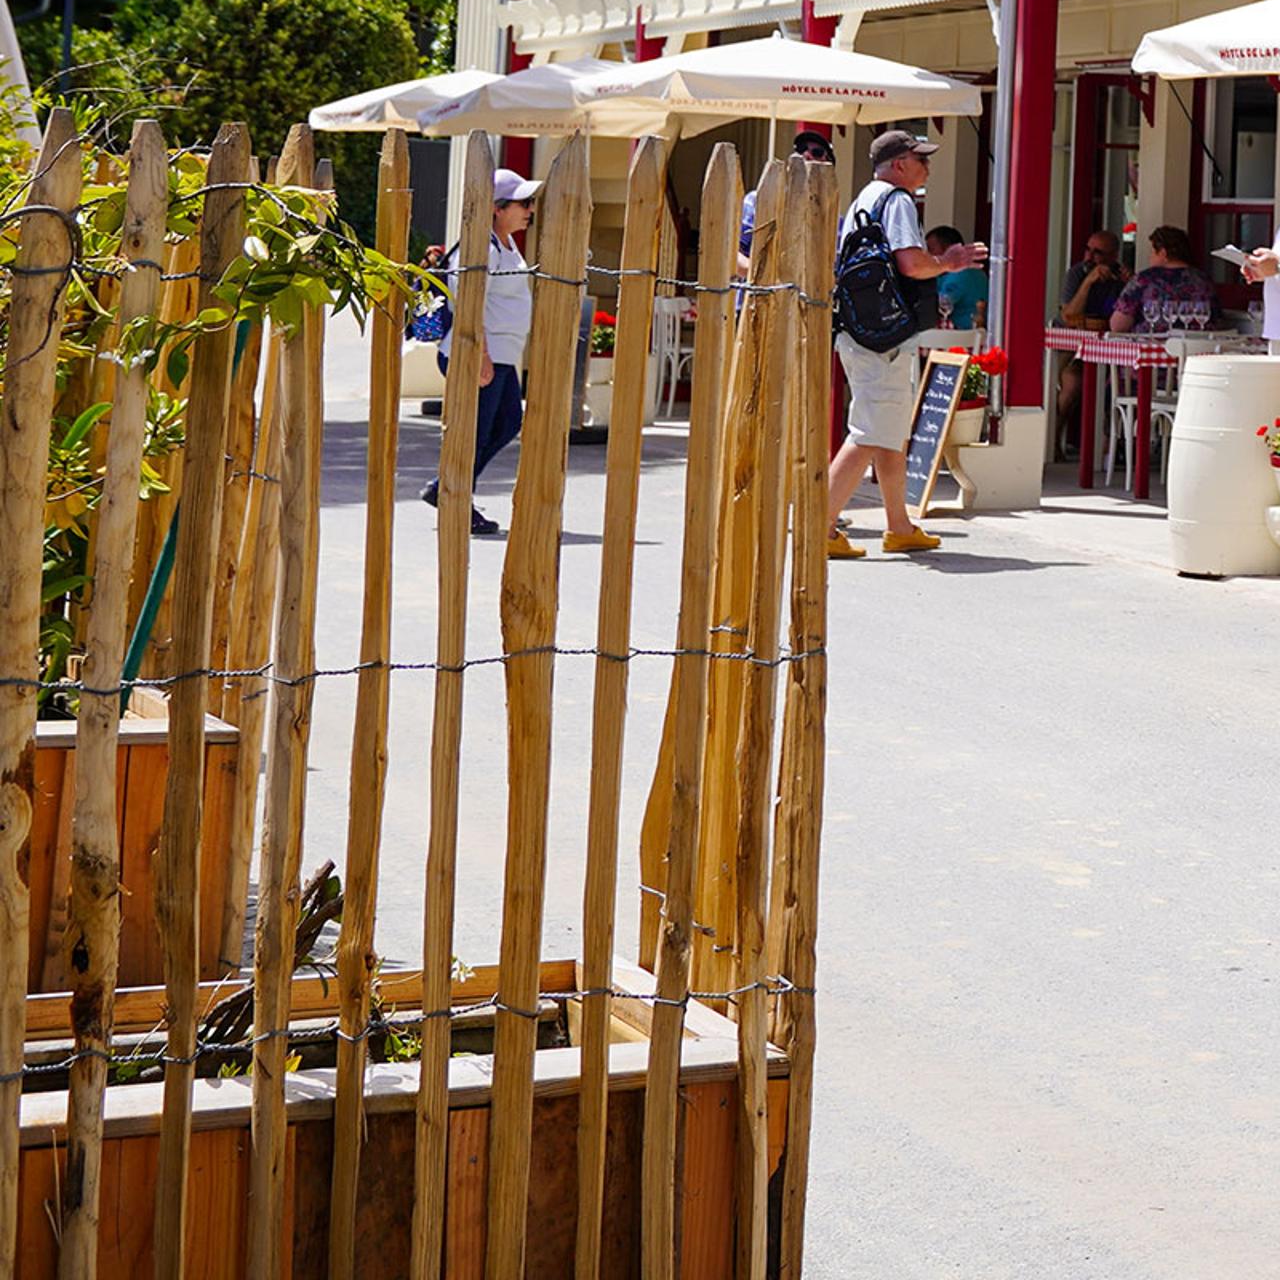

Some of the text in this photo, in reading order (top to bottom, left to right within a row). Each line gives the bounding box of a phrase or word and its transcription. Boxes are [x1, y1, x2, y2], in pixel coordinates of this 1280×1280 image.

[1259, 48, 1271, 58] LA
[782, 83, 887, 98] HÔTEL DE LA PLAGE
